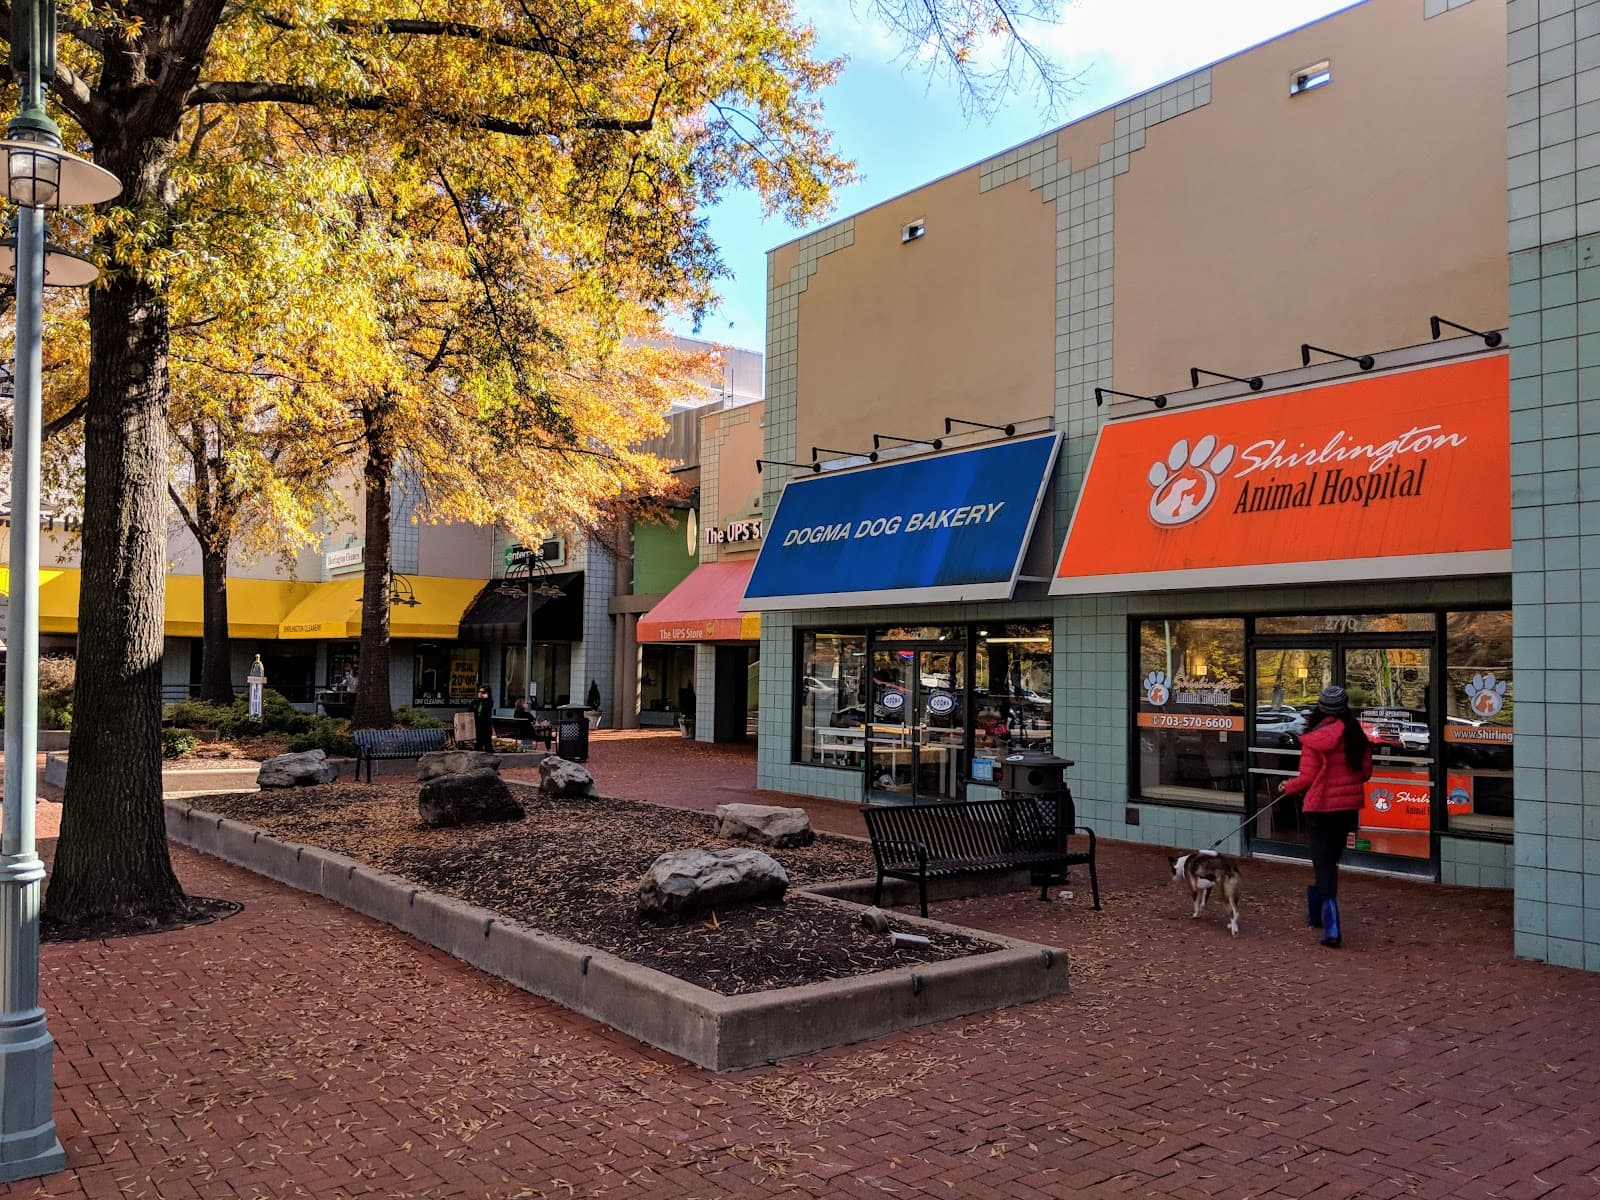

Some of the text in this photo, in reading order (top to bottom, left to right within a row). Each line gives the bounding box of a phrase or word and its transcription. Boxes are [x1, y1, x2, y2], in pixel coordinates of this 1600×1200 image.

[1234, 424, 1468, 479] Shirlington
[1232, 458, 1428, 515] Animal Hospital
[705, 527, 724, 544] The
[727, 523, 750, 542] UPS
[783, 501, 1006, 547] DOGMA DOG BAKERY
[660, 627, 703, 640] The UPS Store
[1325, 616, 1357, 633] 2770
[1161, 716, 1233, 729] 703-570-6600
